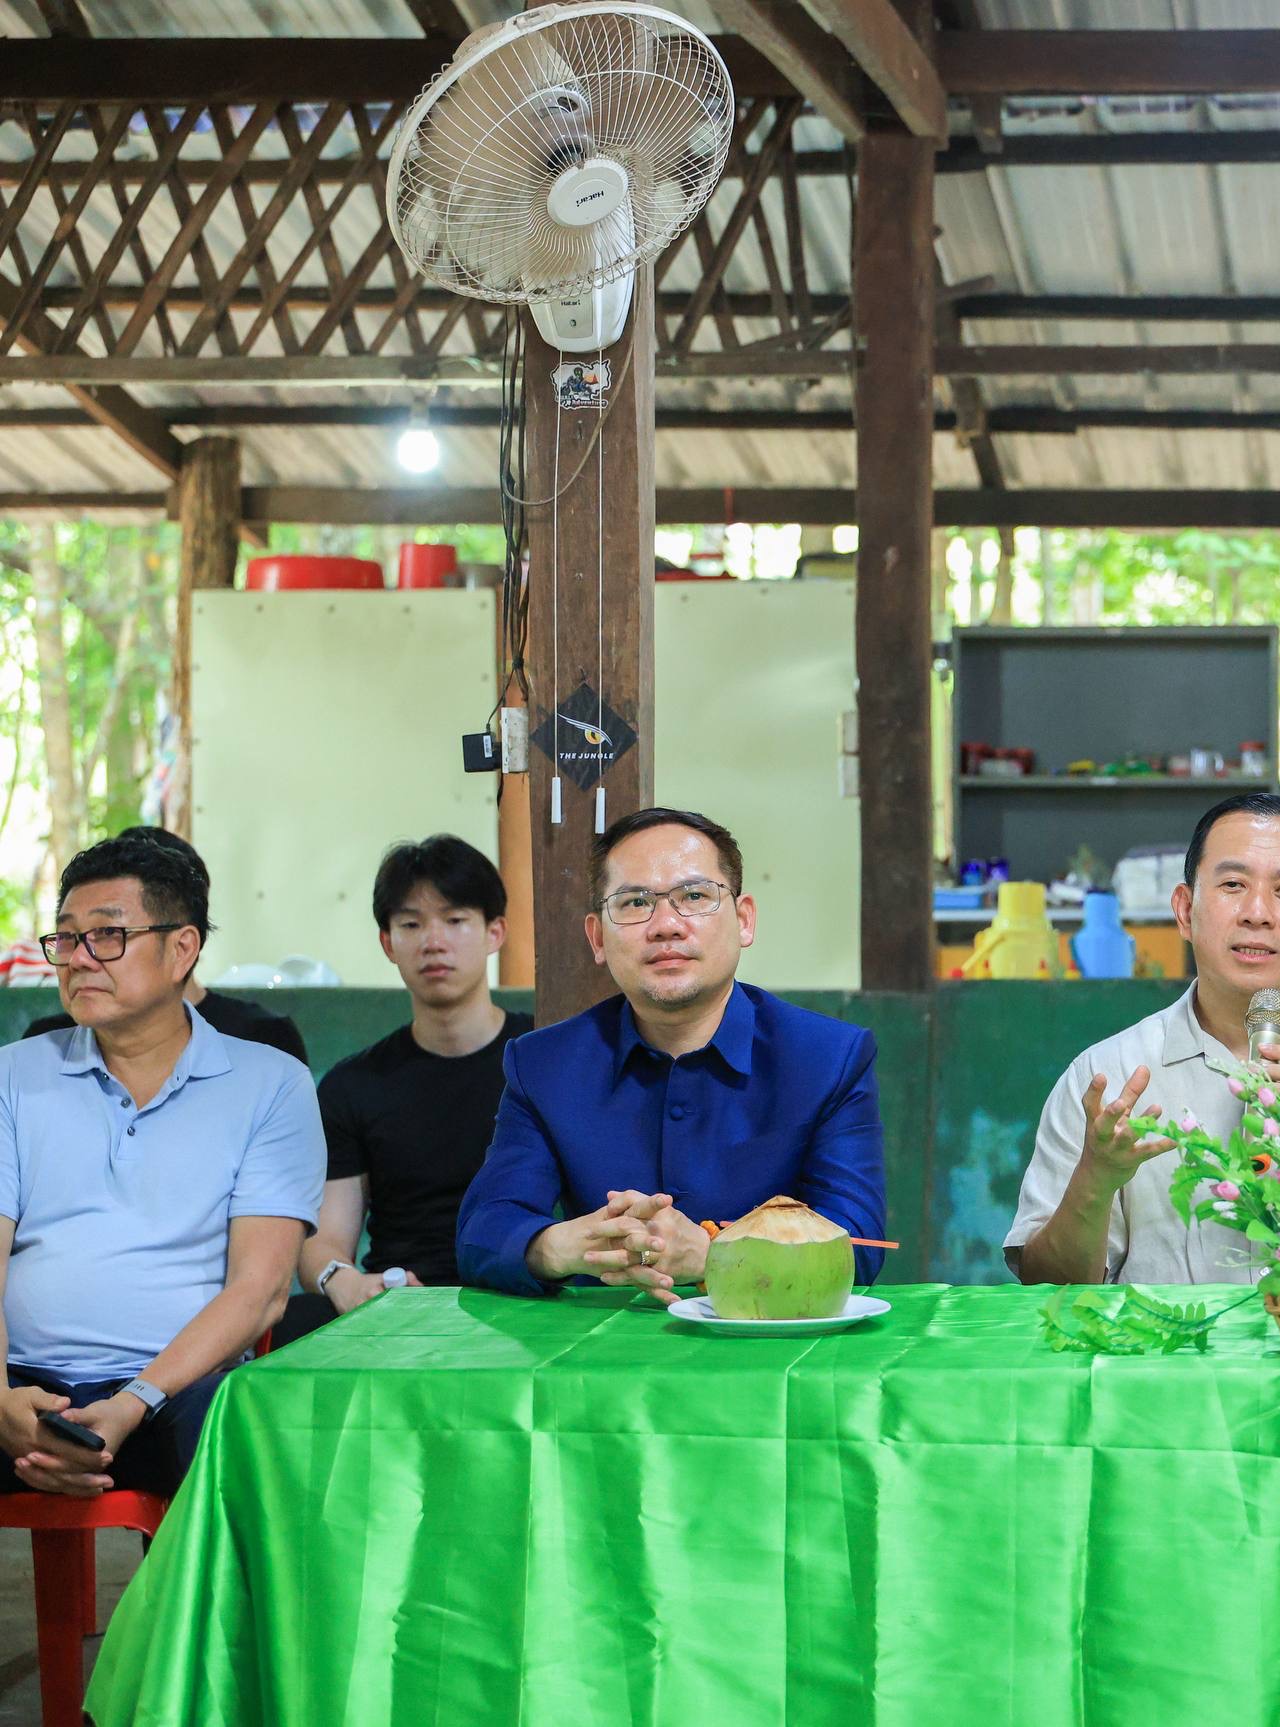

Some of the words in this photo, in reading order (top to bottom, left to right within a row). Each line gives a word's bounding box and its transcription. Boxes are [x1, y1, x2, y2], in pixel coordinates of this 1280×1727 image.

[576, 190, 604, 207] Hatari
[559, 752, 577, 760] THE
[578, 752, 615, 760] JUNGLE
